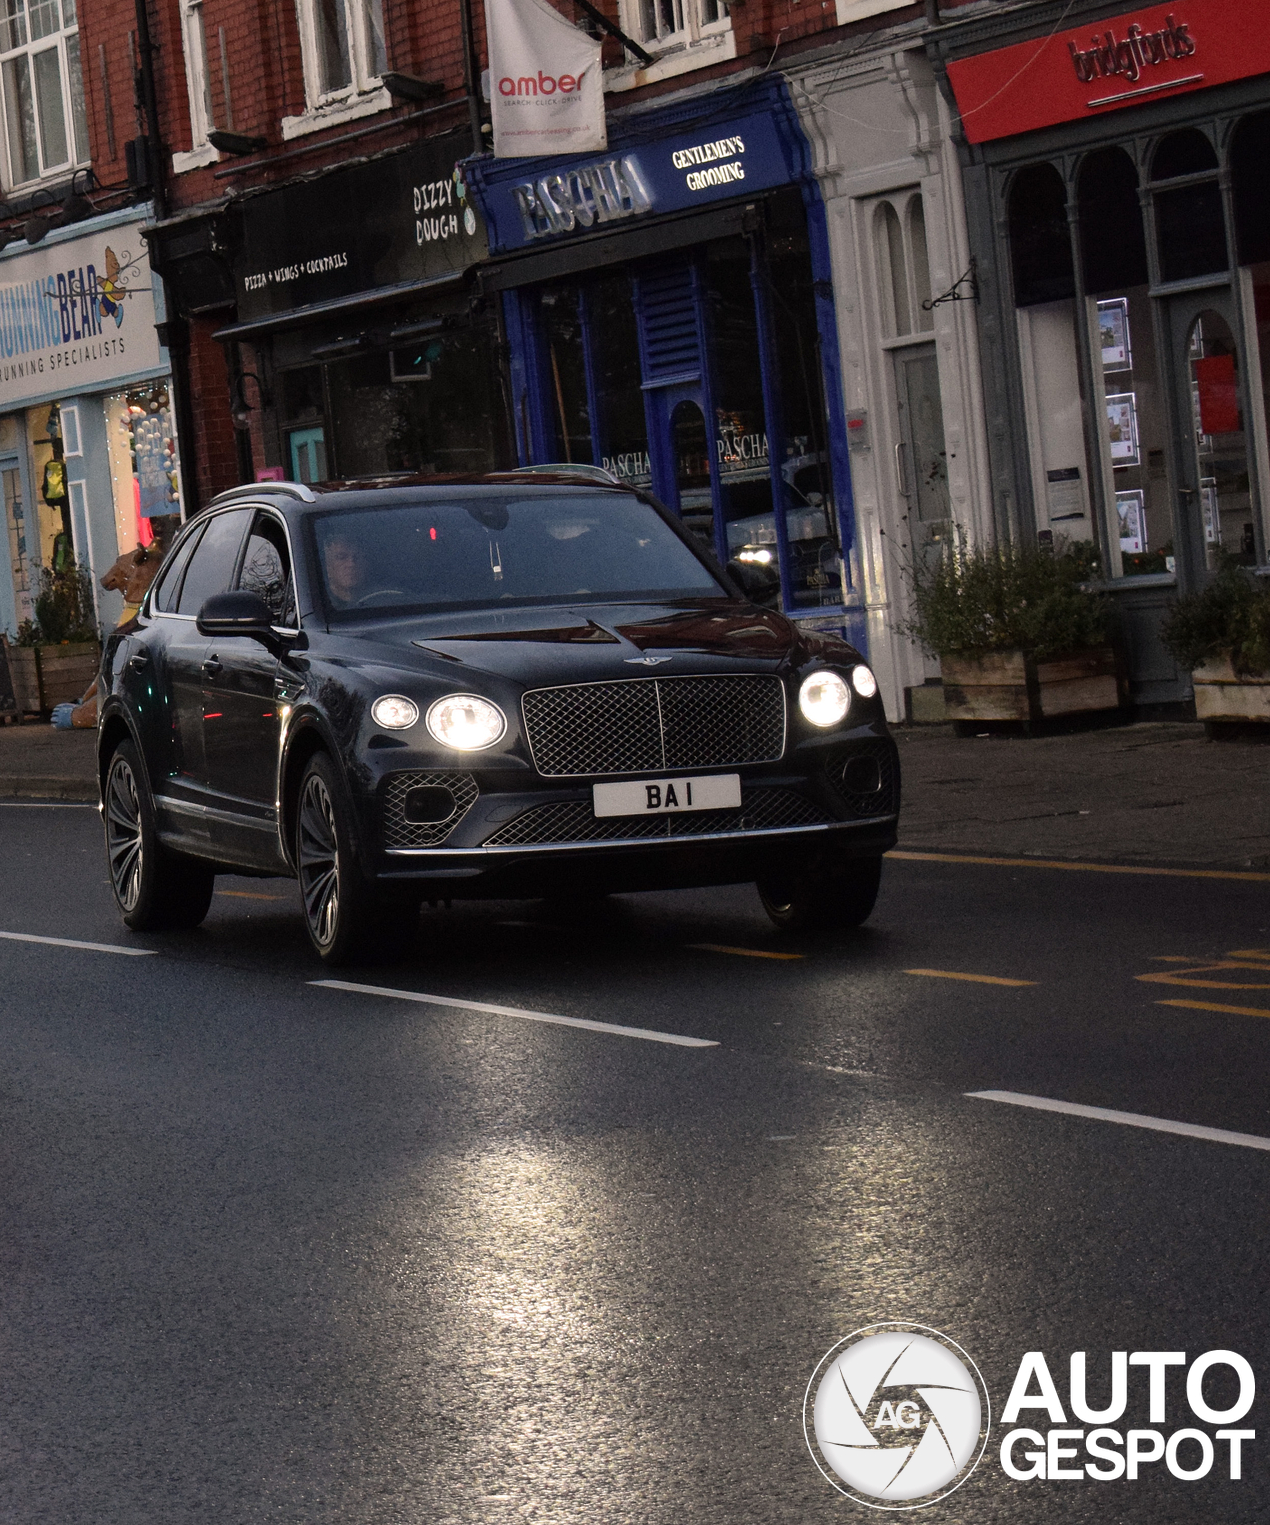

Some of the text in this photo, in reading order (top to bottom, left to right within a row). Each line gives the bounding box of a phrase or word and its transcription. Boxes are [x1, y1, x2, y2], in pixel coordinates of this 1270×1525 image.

[1067, 13, 1196, 82] bridgfords
[498, 70, 586, 96] amber
[504, 95, 582, 107] SEARCH CLICK DRIVE
[672, 136, 745, 170] GENTLEMEN'S
[686, 161, 745, 191] GROOMING
[413, 179, 453, 214] DIZZY
[508, 154, 653, 241] PASCHA
[416, 215, 458, 246] DOUGH
[244, 273, 267, 292] PIZZA
[274, 264, 299, 283] WINGS
[306, 252, 348, 275] COCKTAILS
[50, 338, 125, 370] SPECIALISTS
[716, 433, 769, 463] PASCHA
[602, 451, 652, 478] PASCHA
[645, 783, 678, 809] BA
